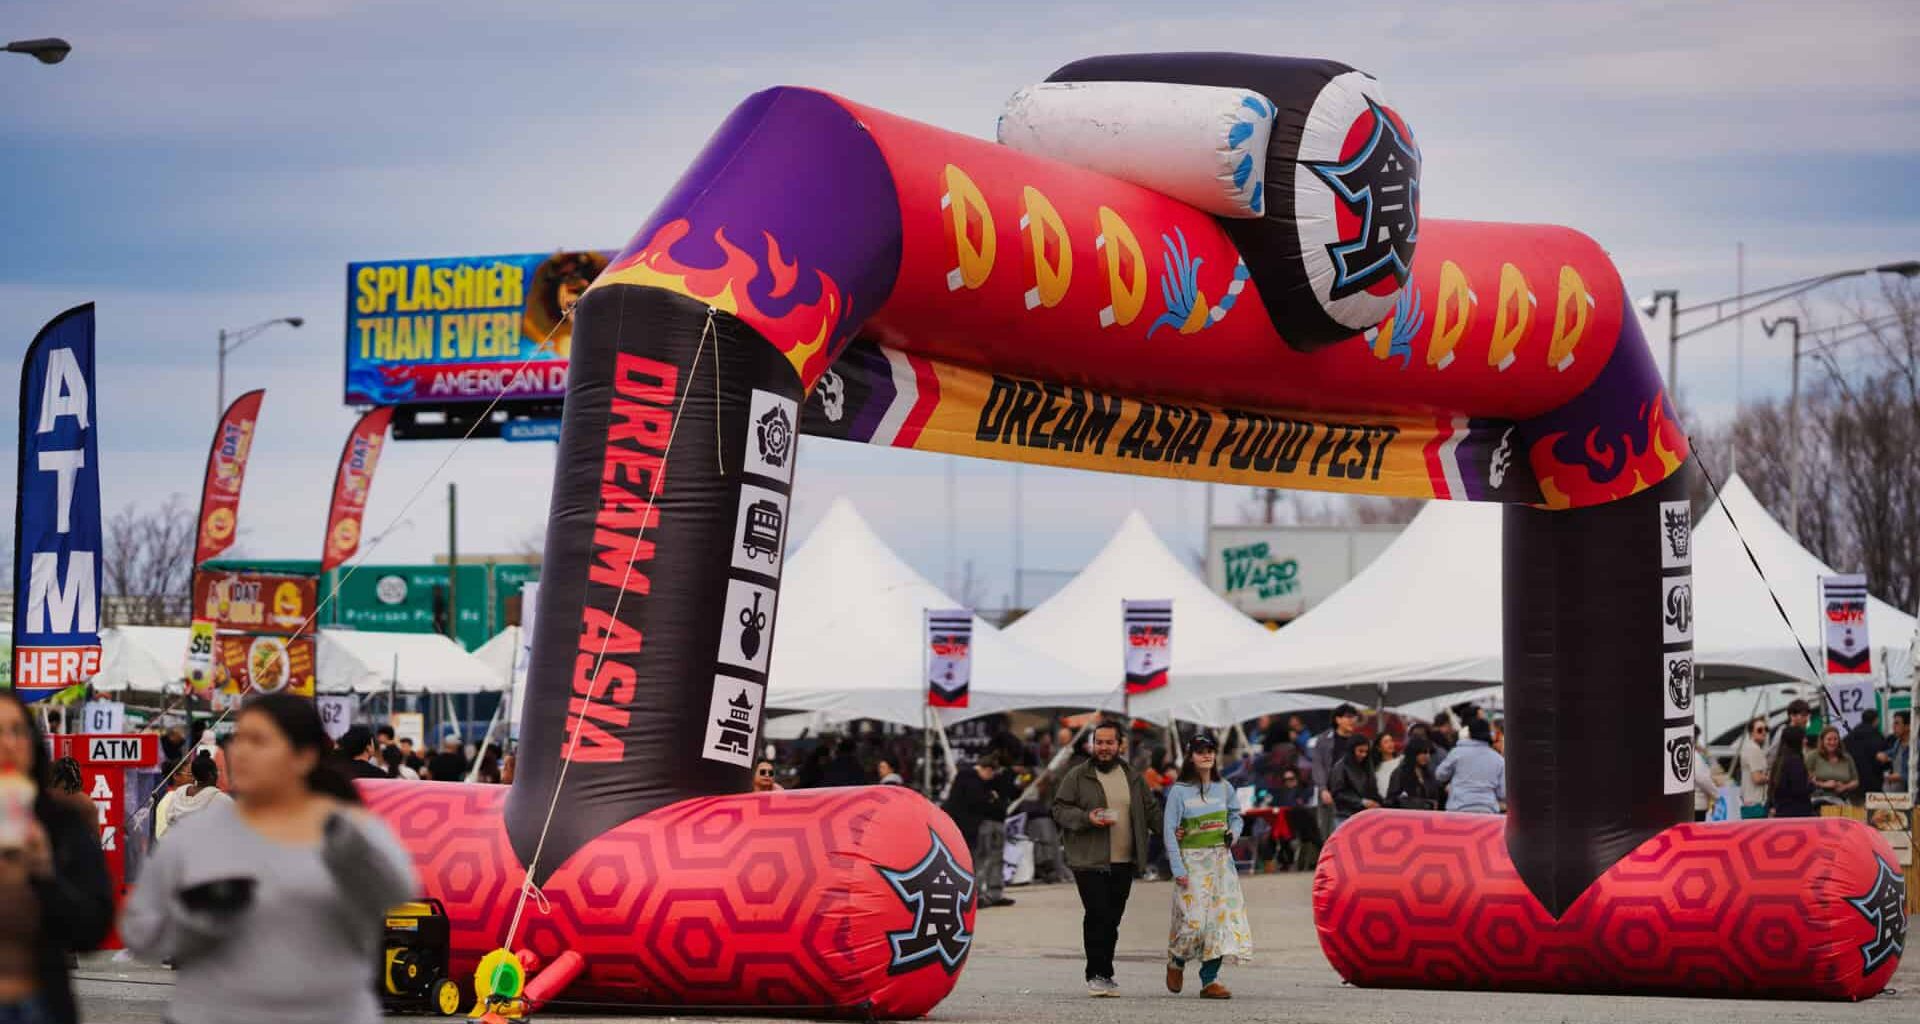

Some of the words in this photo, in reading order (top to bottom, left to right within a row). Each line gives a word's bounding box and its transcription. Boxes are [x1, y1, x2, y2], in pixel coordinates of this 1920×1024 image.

[357, 262, 523, 313] SPLASHIER
[357, 316, 433, 360] THAN
[440, 312, 521, 358] EVER!
[431, 368, 544, 394] AMERICAN
[976, 375, 1122, 455] DREAM
[1117, 403, 1213, 465] ASIA
[1209, 409, 1315, 473] FOOD
[1309, 423, 1400, 480] FEST
[26, 347, 97, 634] ATM
[588, 352, 678, 596] DREAM
[19, 651, 99, 684] HERE
[560, 606, 643, 763] ASIA
[94, 711, 112, 730] G1
[322, 703, 342, 724] G2
[1839, 688, 1863, 713] E2
[92, 740, 138, 759] ATM
